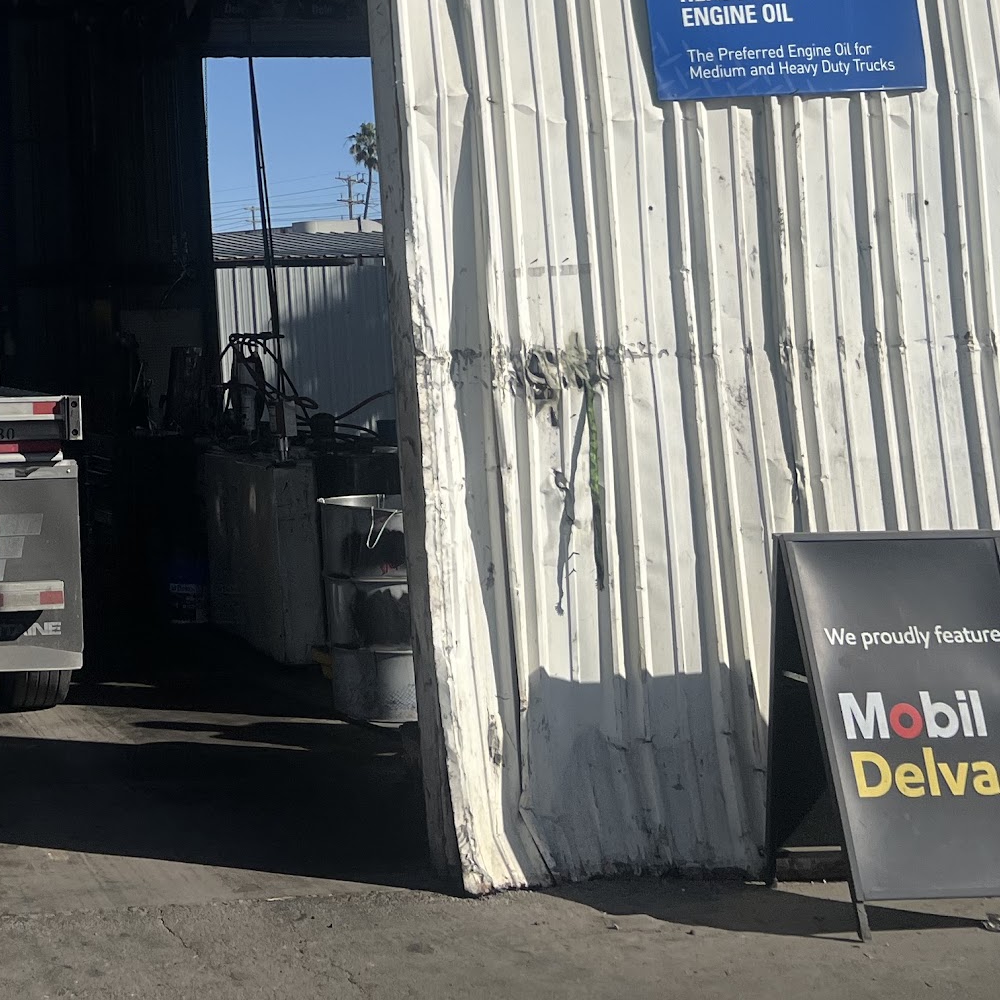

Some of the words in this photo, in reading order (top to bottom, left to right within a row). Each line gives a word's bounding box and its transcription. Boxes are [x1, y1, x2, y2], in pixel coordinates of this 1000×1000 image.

[681, 4, 758, 27] ENGINE
[762, 2, 794, 24] OIL
[687, 49, 714, 63] The
[718, 45, 785, 61] Preferred
[788, 43, 832, 61] Engine
[835, 42, 852, 56] Oil
[854, 42, 873, 56] for
[689, 64, 747, 80] Medium
[750, 62, 776, 77] and
[779, 60, 819, 78] Heavy
[822, 59, 851, 76] Duty
[854, 57, 896, 72] Trucks
[824, 627, 858, 647] We
[861, 625, 931, 650] proudly
[933, 624, 1000, 645] feature
[838, 689, 989, 741] Mobil
[850, 746, 1000, 799] Delva
